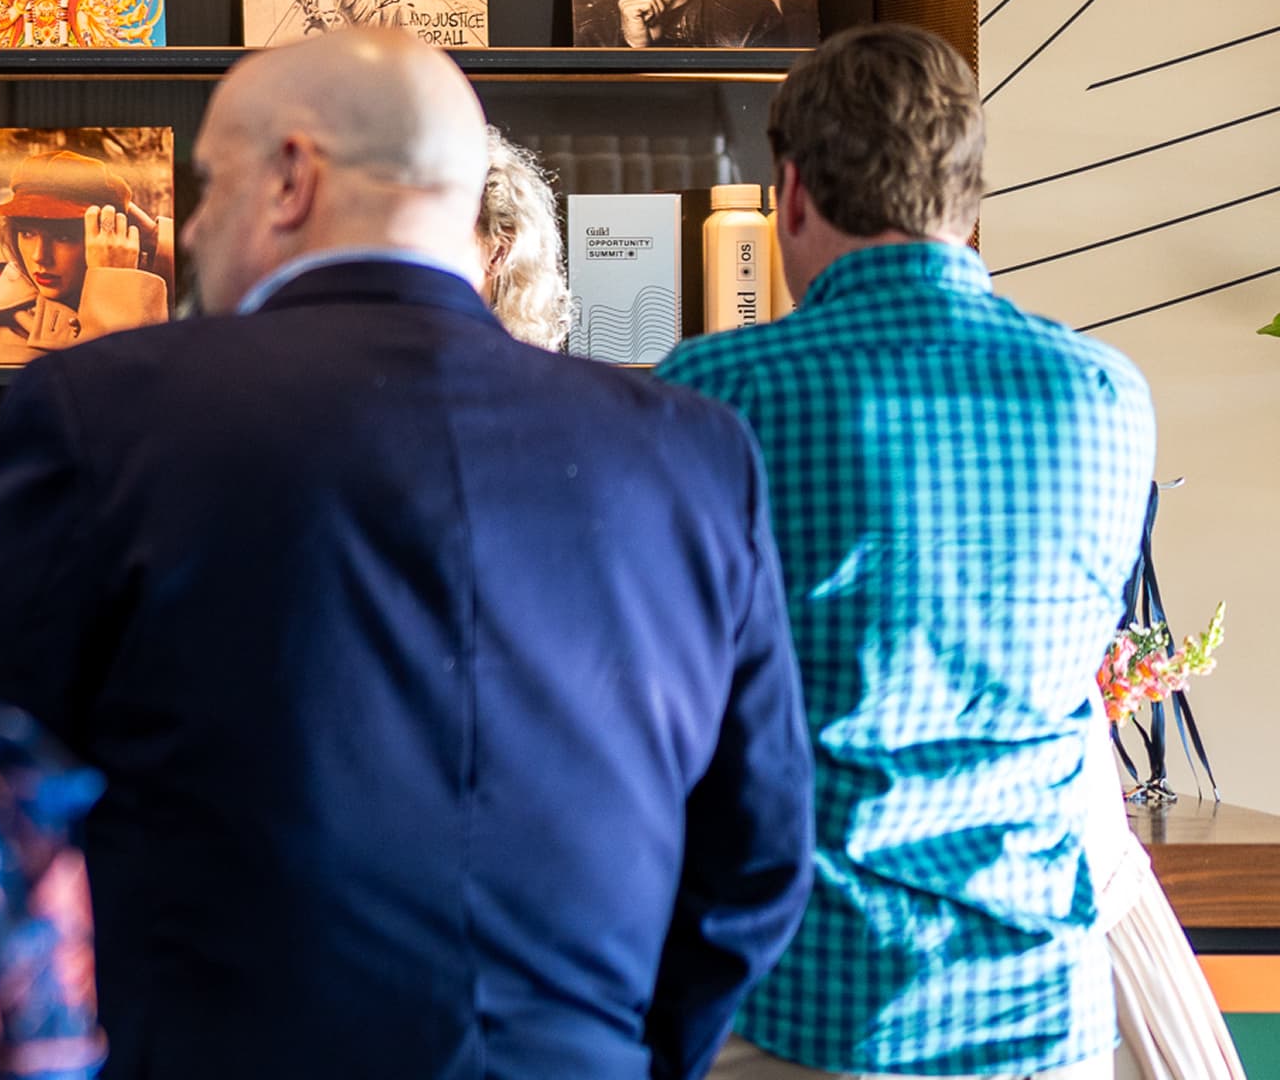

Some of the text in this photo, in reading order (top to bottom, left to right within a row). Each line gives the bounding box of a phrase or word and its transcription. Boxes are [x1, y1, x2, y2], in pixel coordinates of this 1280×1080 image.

[432, 11, 485, 28] JUSTICE
[417, 30, 468, 45] FOR ALL
[588, 239, 650, 247] OPPORTUNITY
[589, 250, 625, 258] SUMMIT
[741, 243, 752, 261] OS
[737, 291, 756, 327] uild
